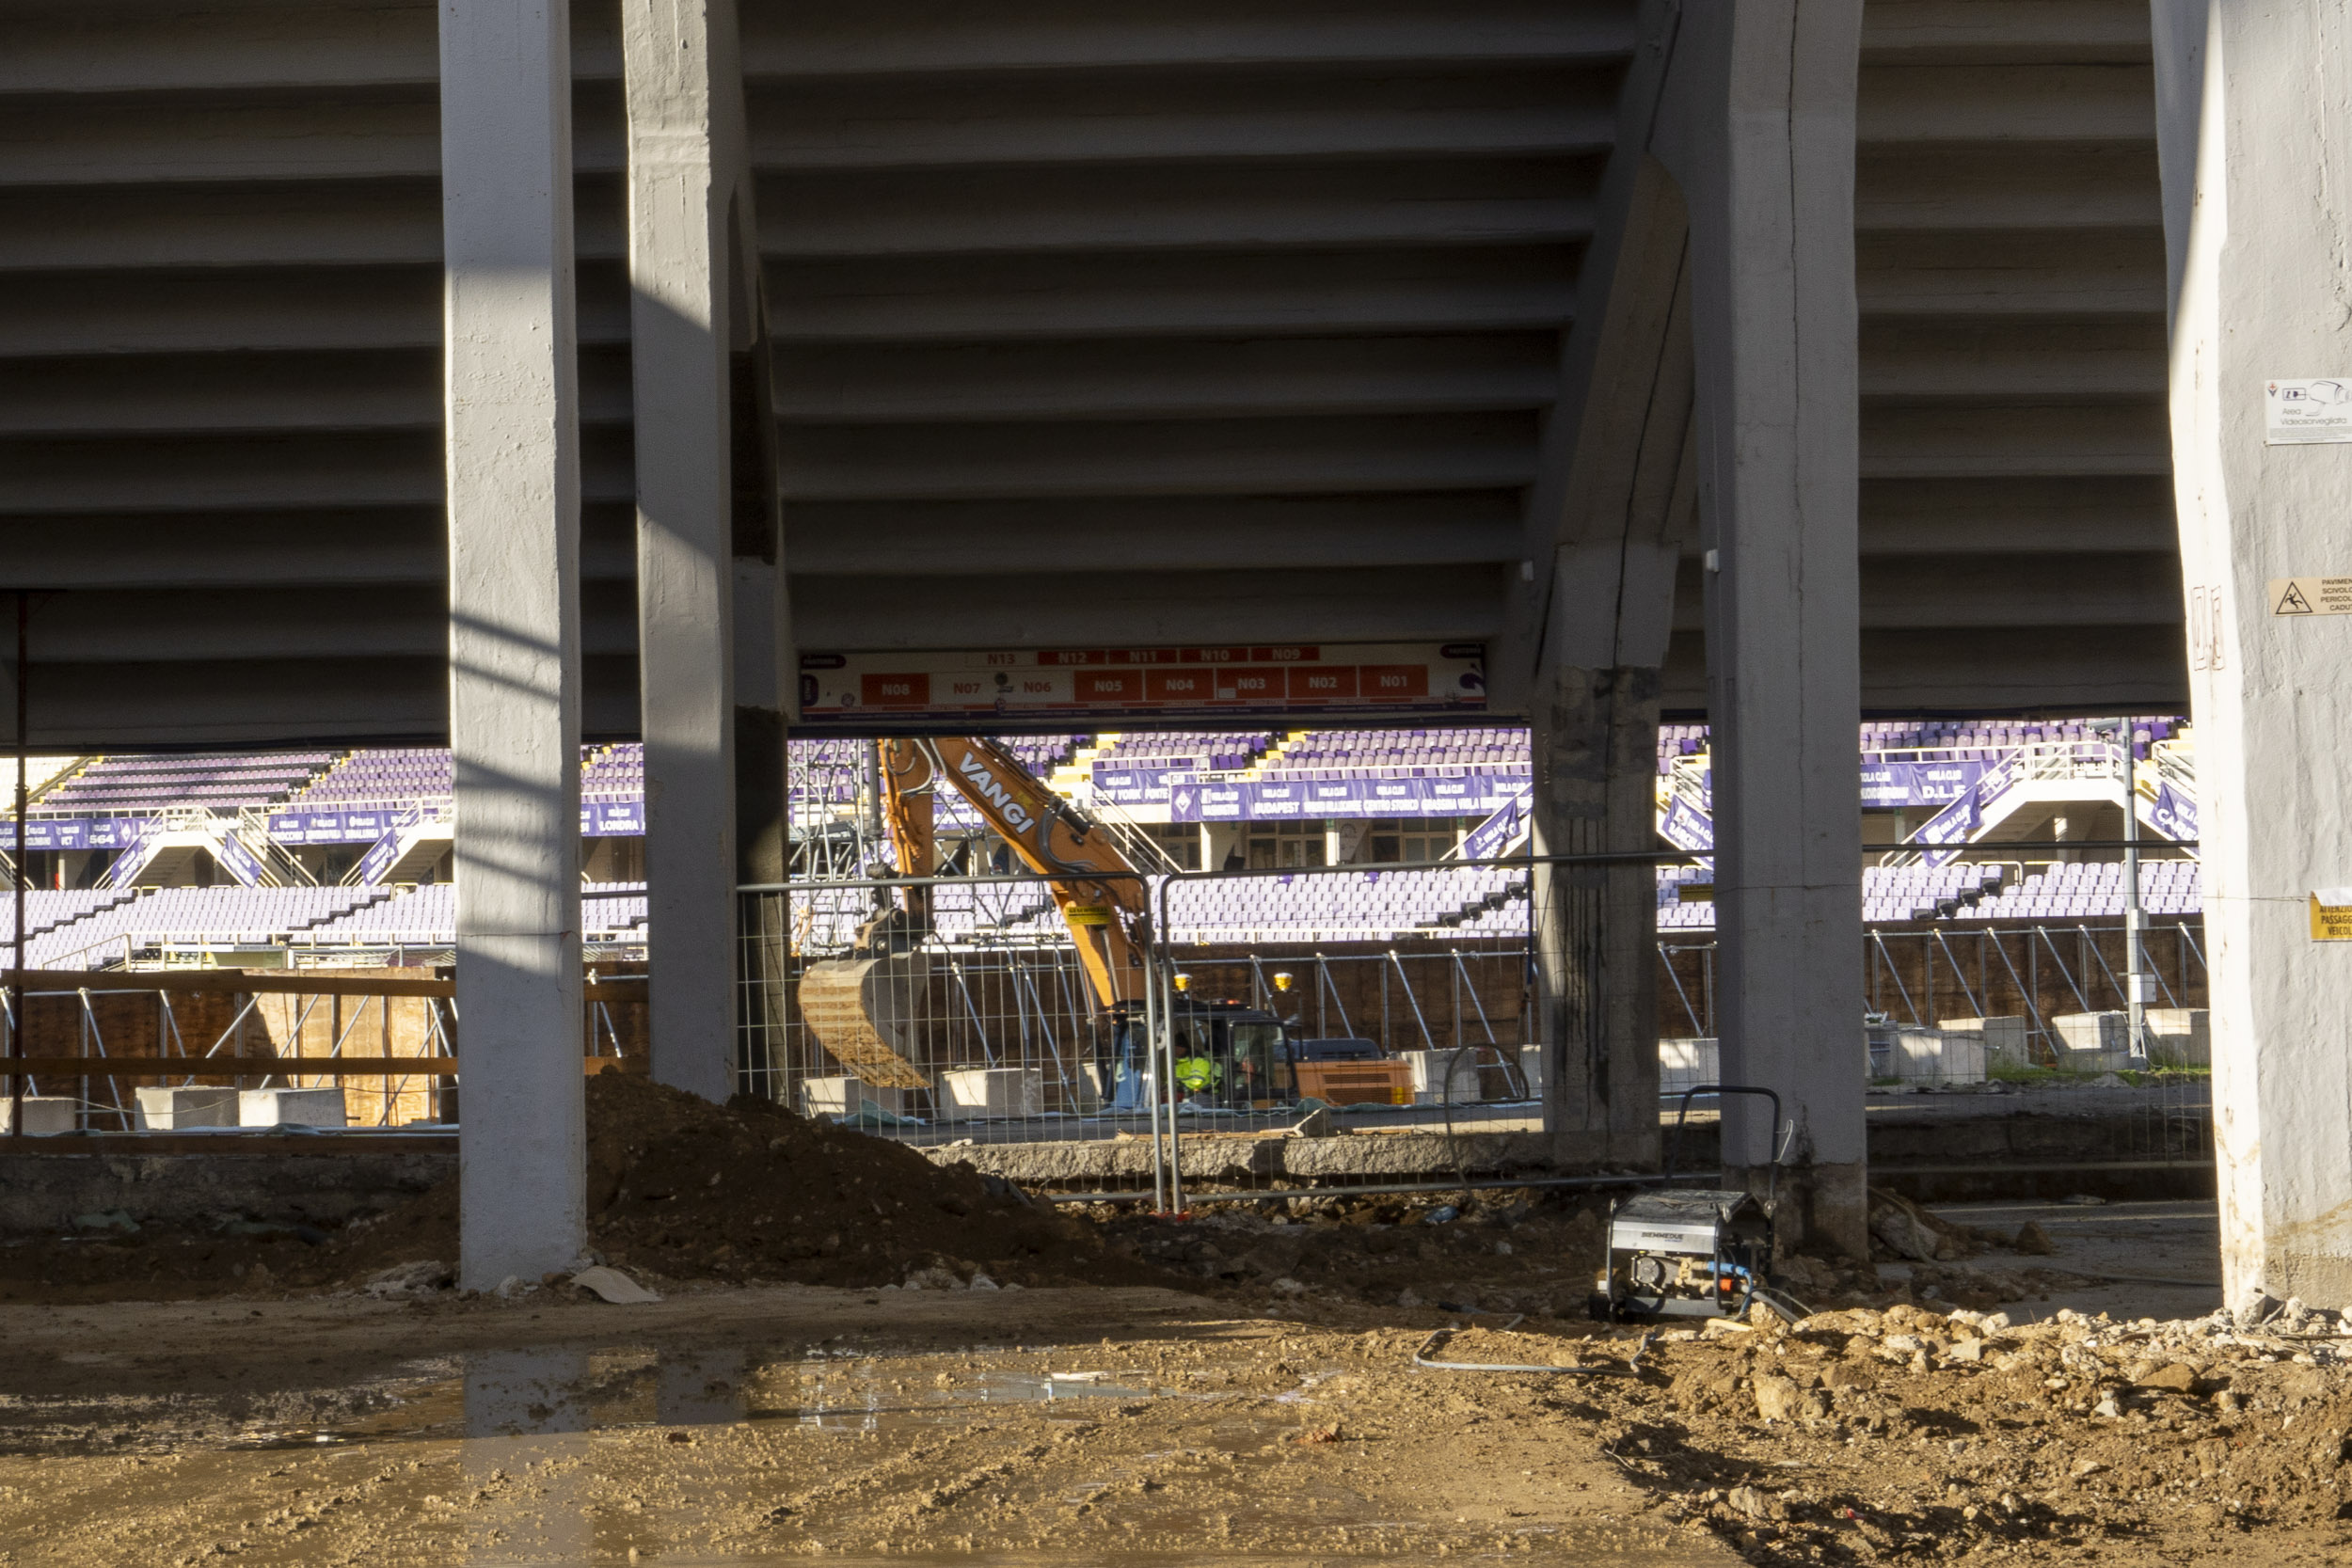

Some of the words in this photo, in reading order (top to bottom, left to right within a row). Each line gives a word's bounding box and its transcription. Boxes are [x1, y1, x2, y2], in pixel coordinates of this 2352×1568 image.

[2280, 417, 2347, 425] Videosorvegliata
[988, 654, 1015, 664] N13
[1058, 652, 1087, 664] N12
[1129, 651, 1157, 662] N11
[1200, 649, 1231, 661] N10
[1272, 648, 1301, 659] N09
[1024, 681, 1052, 692] N06
[1094, 679, 1123, 691] N05
[1166, 678, 1195, 690] N04
[1238, 677, 1266, 689] N03
[1309, 676, 1338, 689] N02
[1380, 675, 1407, 688] N01
[882, 684, 911, 696] N08
[954, 683, 981, 694] N07
[960, 752, 1035, 833] VANGI
[1254, 801, 1300, 815] BUDAPEST
[599, 819, 640, 832] LONDRA
[89, 834, 115, 845] 564
